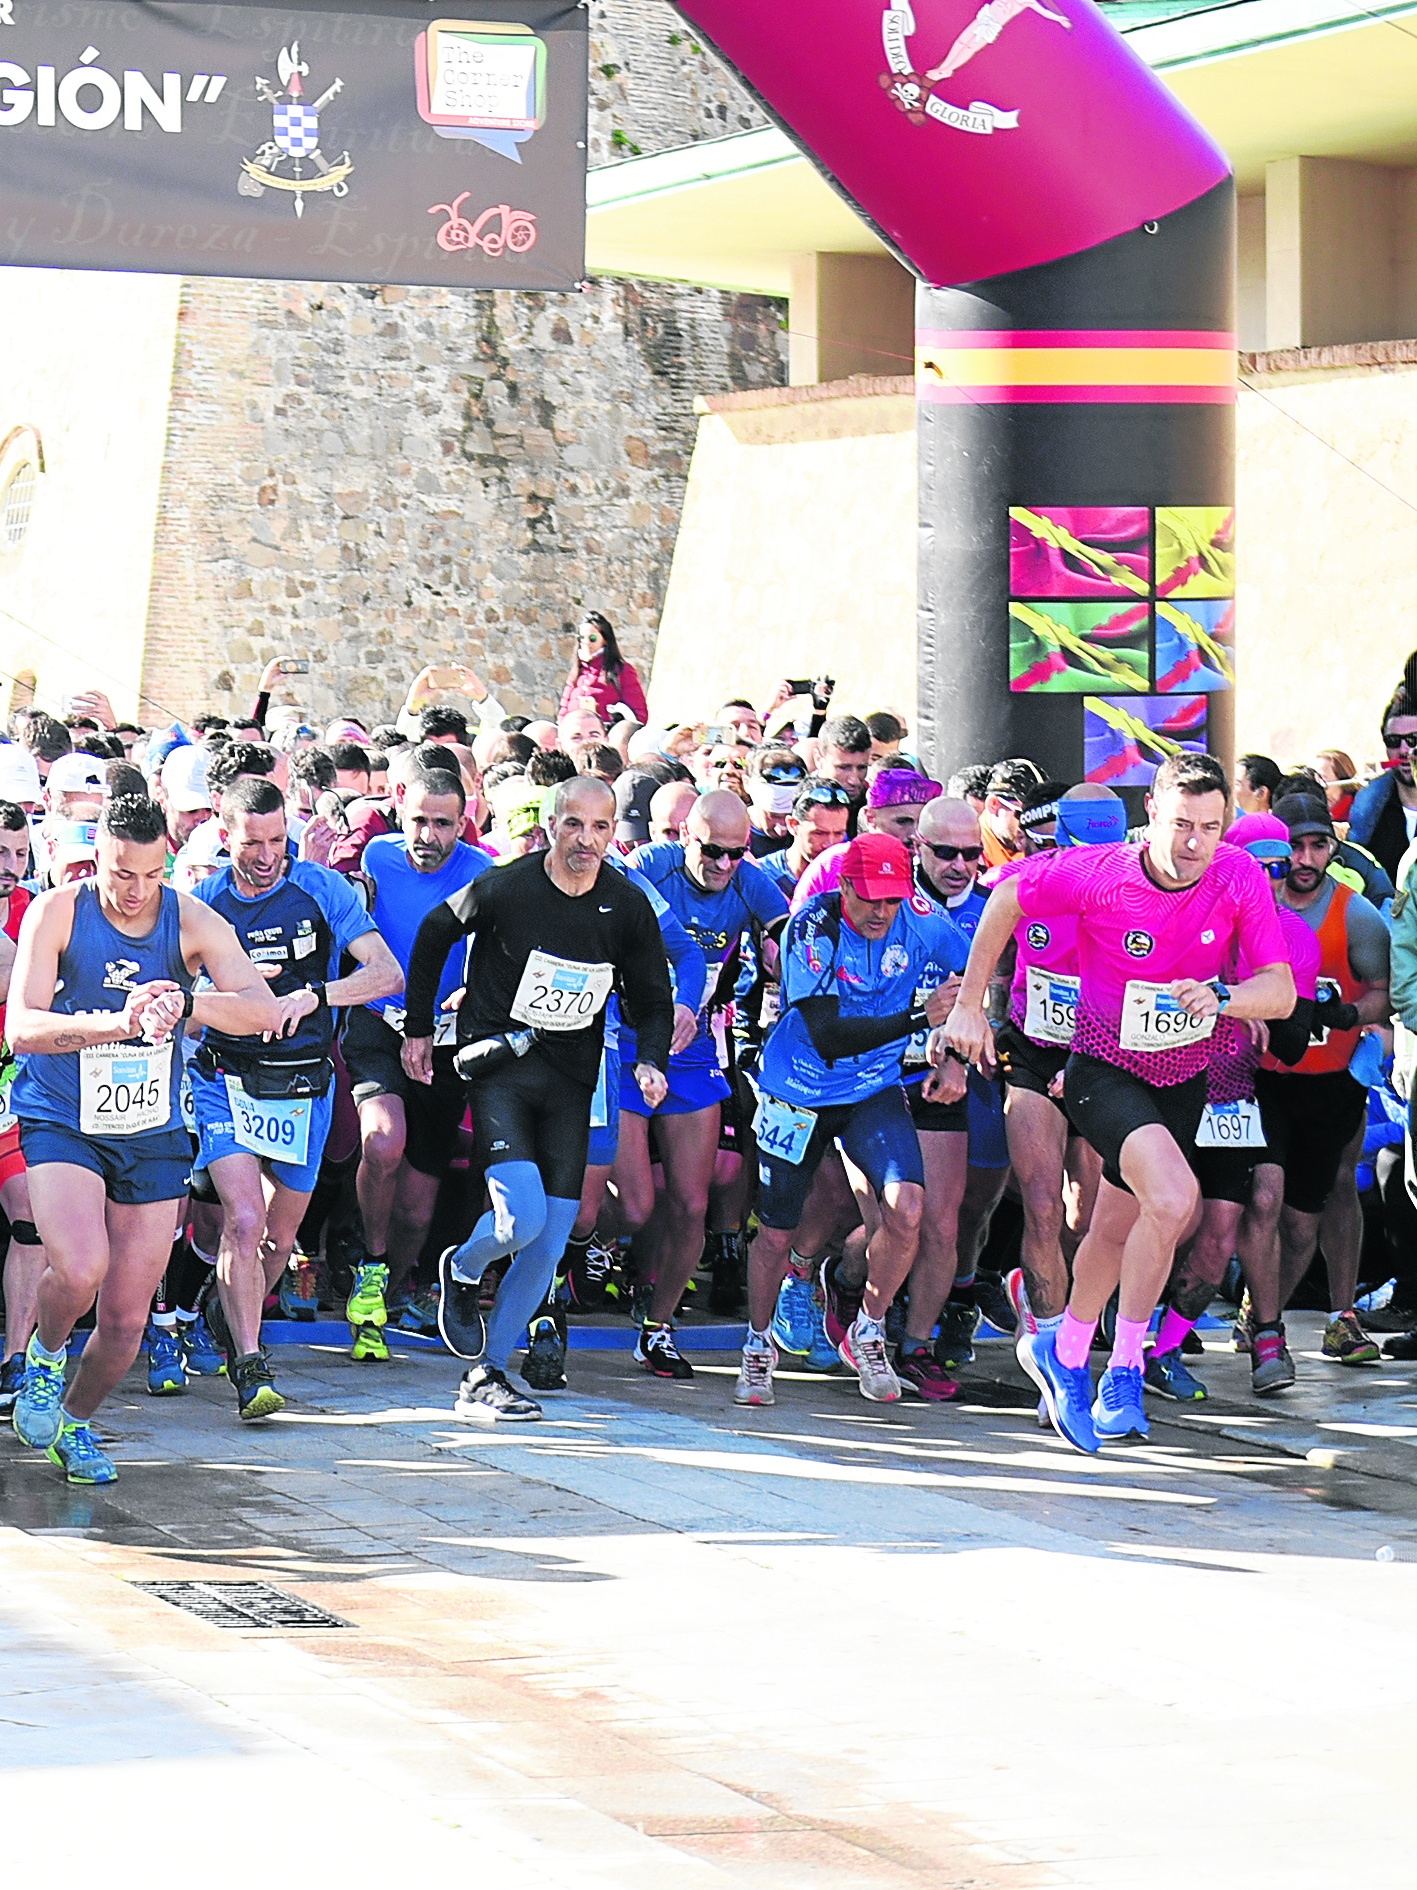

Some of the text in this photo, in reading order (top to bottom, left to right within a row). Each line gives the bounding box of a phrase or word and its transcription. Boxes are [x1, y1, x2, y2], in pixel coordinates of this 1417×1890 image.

[442, 46, 484, 63] The
[443, 69, 523, 87] Corner
[445, 89, 499, 113] Shop
[930, 101, 987, 130] GLORIA
[528, 985, 594, 1014] 2370
[113, 1066, 137, 1074] Sanitas
[96, 1078, 159, 1113] 2045
[94, 1114, 126, 1122] NOSSAIR
[241, 1110, 295, 1146] 3209
[1206, 1114, 1251, 1140] 1697
